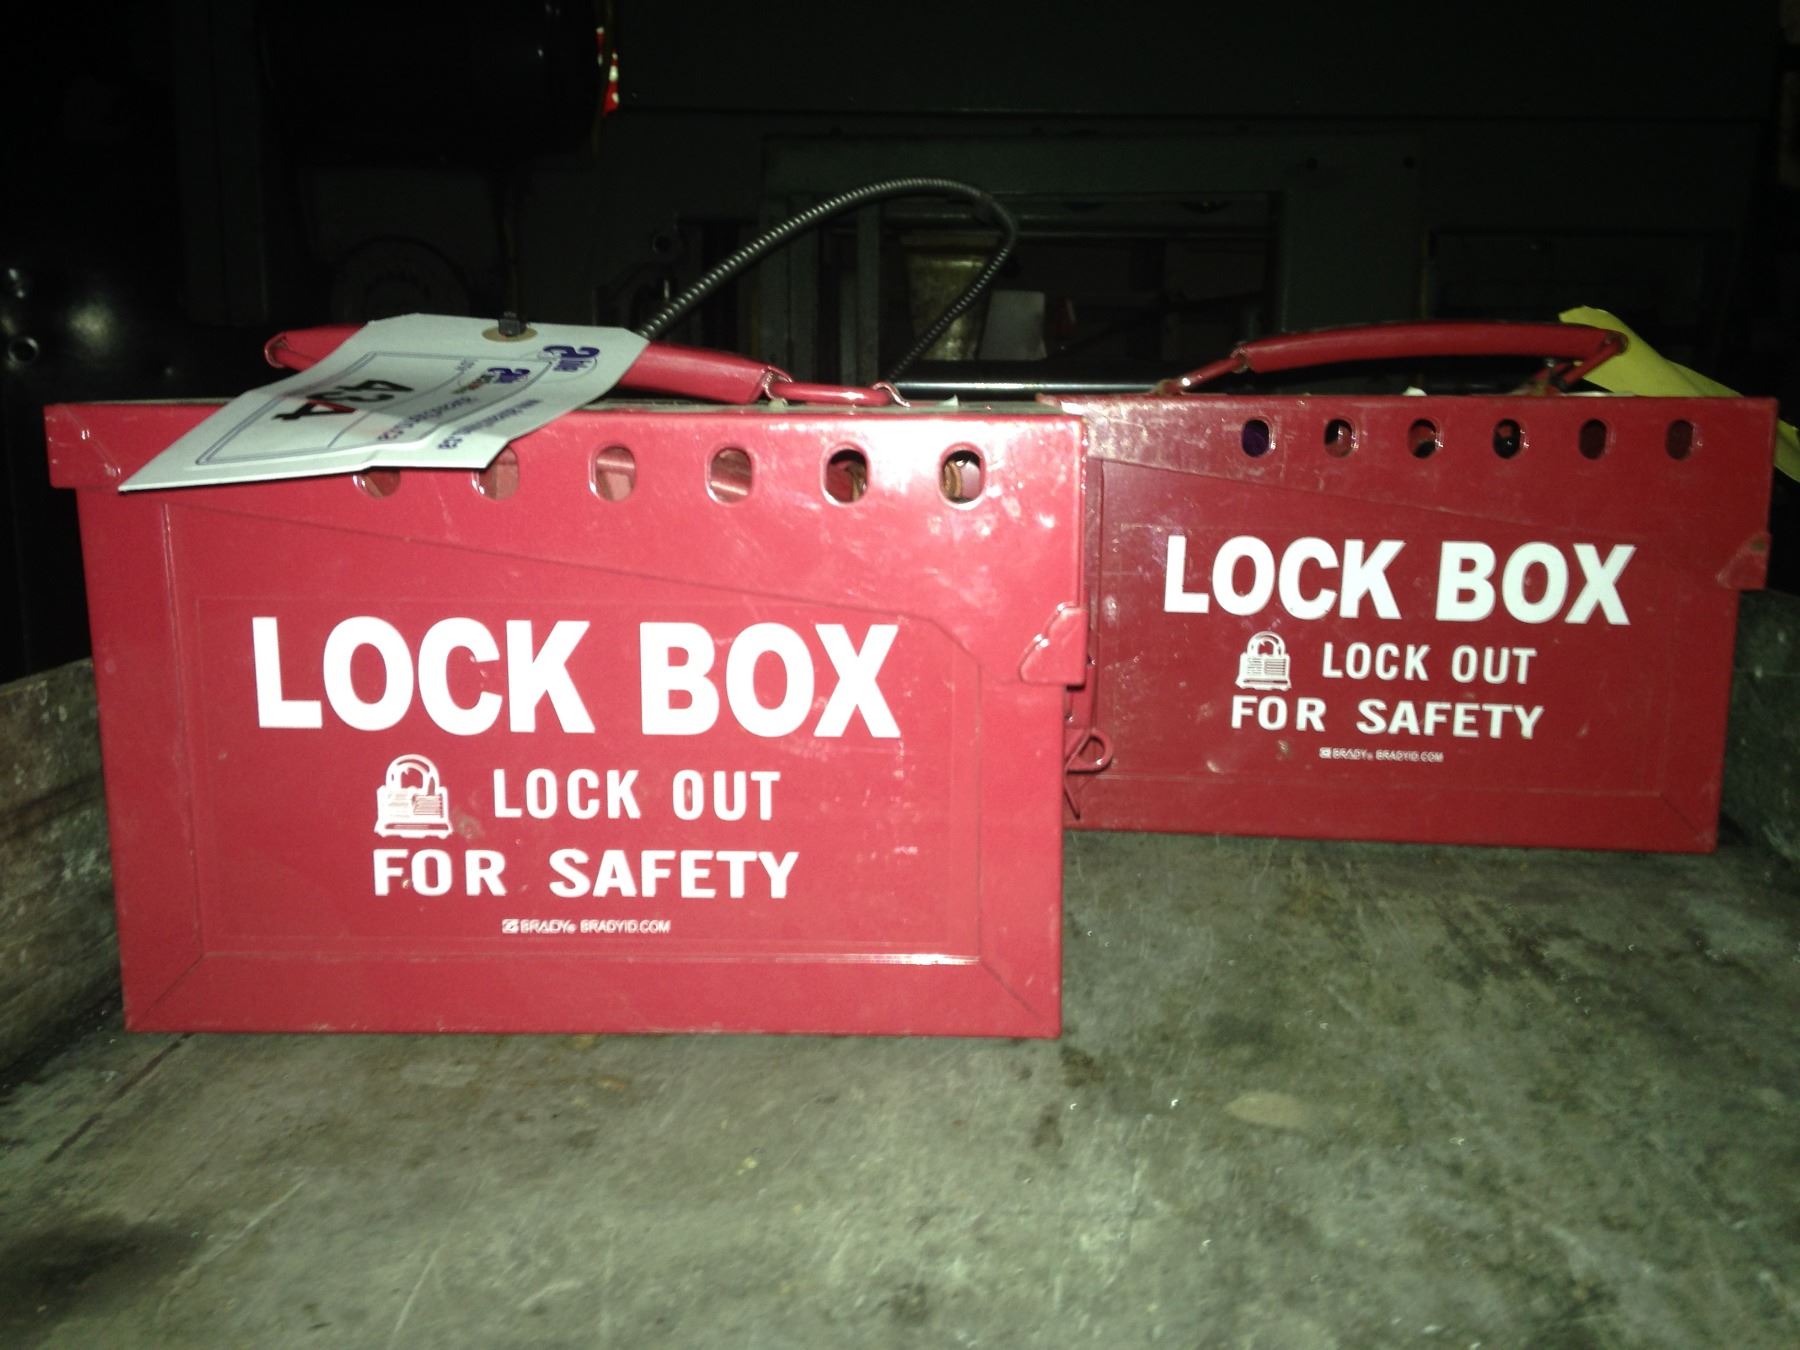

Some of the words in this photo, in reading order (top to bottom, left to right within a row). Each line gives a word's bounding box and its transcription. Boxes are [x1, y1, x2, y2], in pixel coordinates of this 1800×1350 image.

[1163, 534, 1406, 620] LOCK
[1435, 541, 1635, 625] BOX
[252, 616, 597, 736] LOCK
[639, 621, 904, 739] BOX
[1322, 642, 1430, 682] LOCK
[1451, 645, 1537, 685] OUT
[1231, 694, 1328, 732] FOR
[1356, 698, 1544, 740] SAFETY
[1375, 749, 1445, 763] BRADYID.COM
[492, 767, 642, 821] LOCK
[672, 768, 782, 823] OUT
[372, 848, 508, 898] FOR
[548, 847, 800, 901] SAFETY
[579, 918, 673, 934] BRADYID.COM
